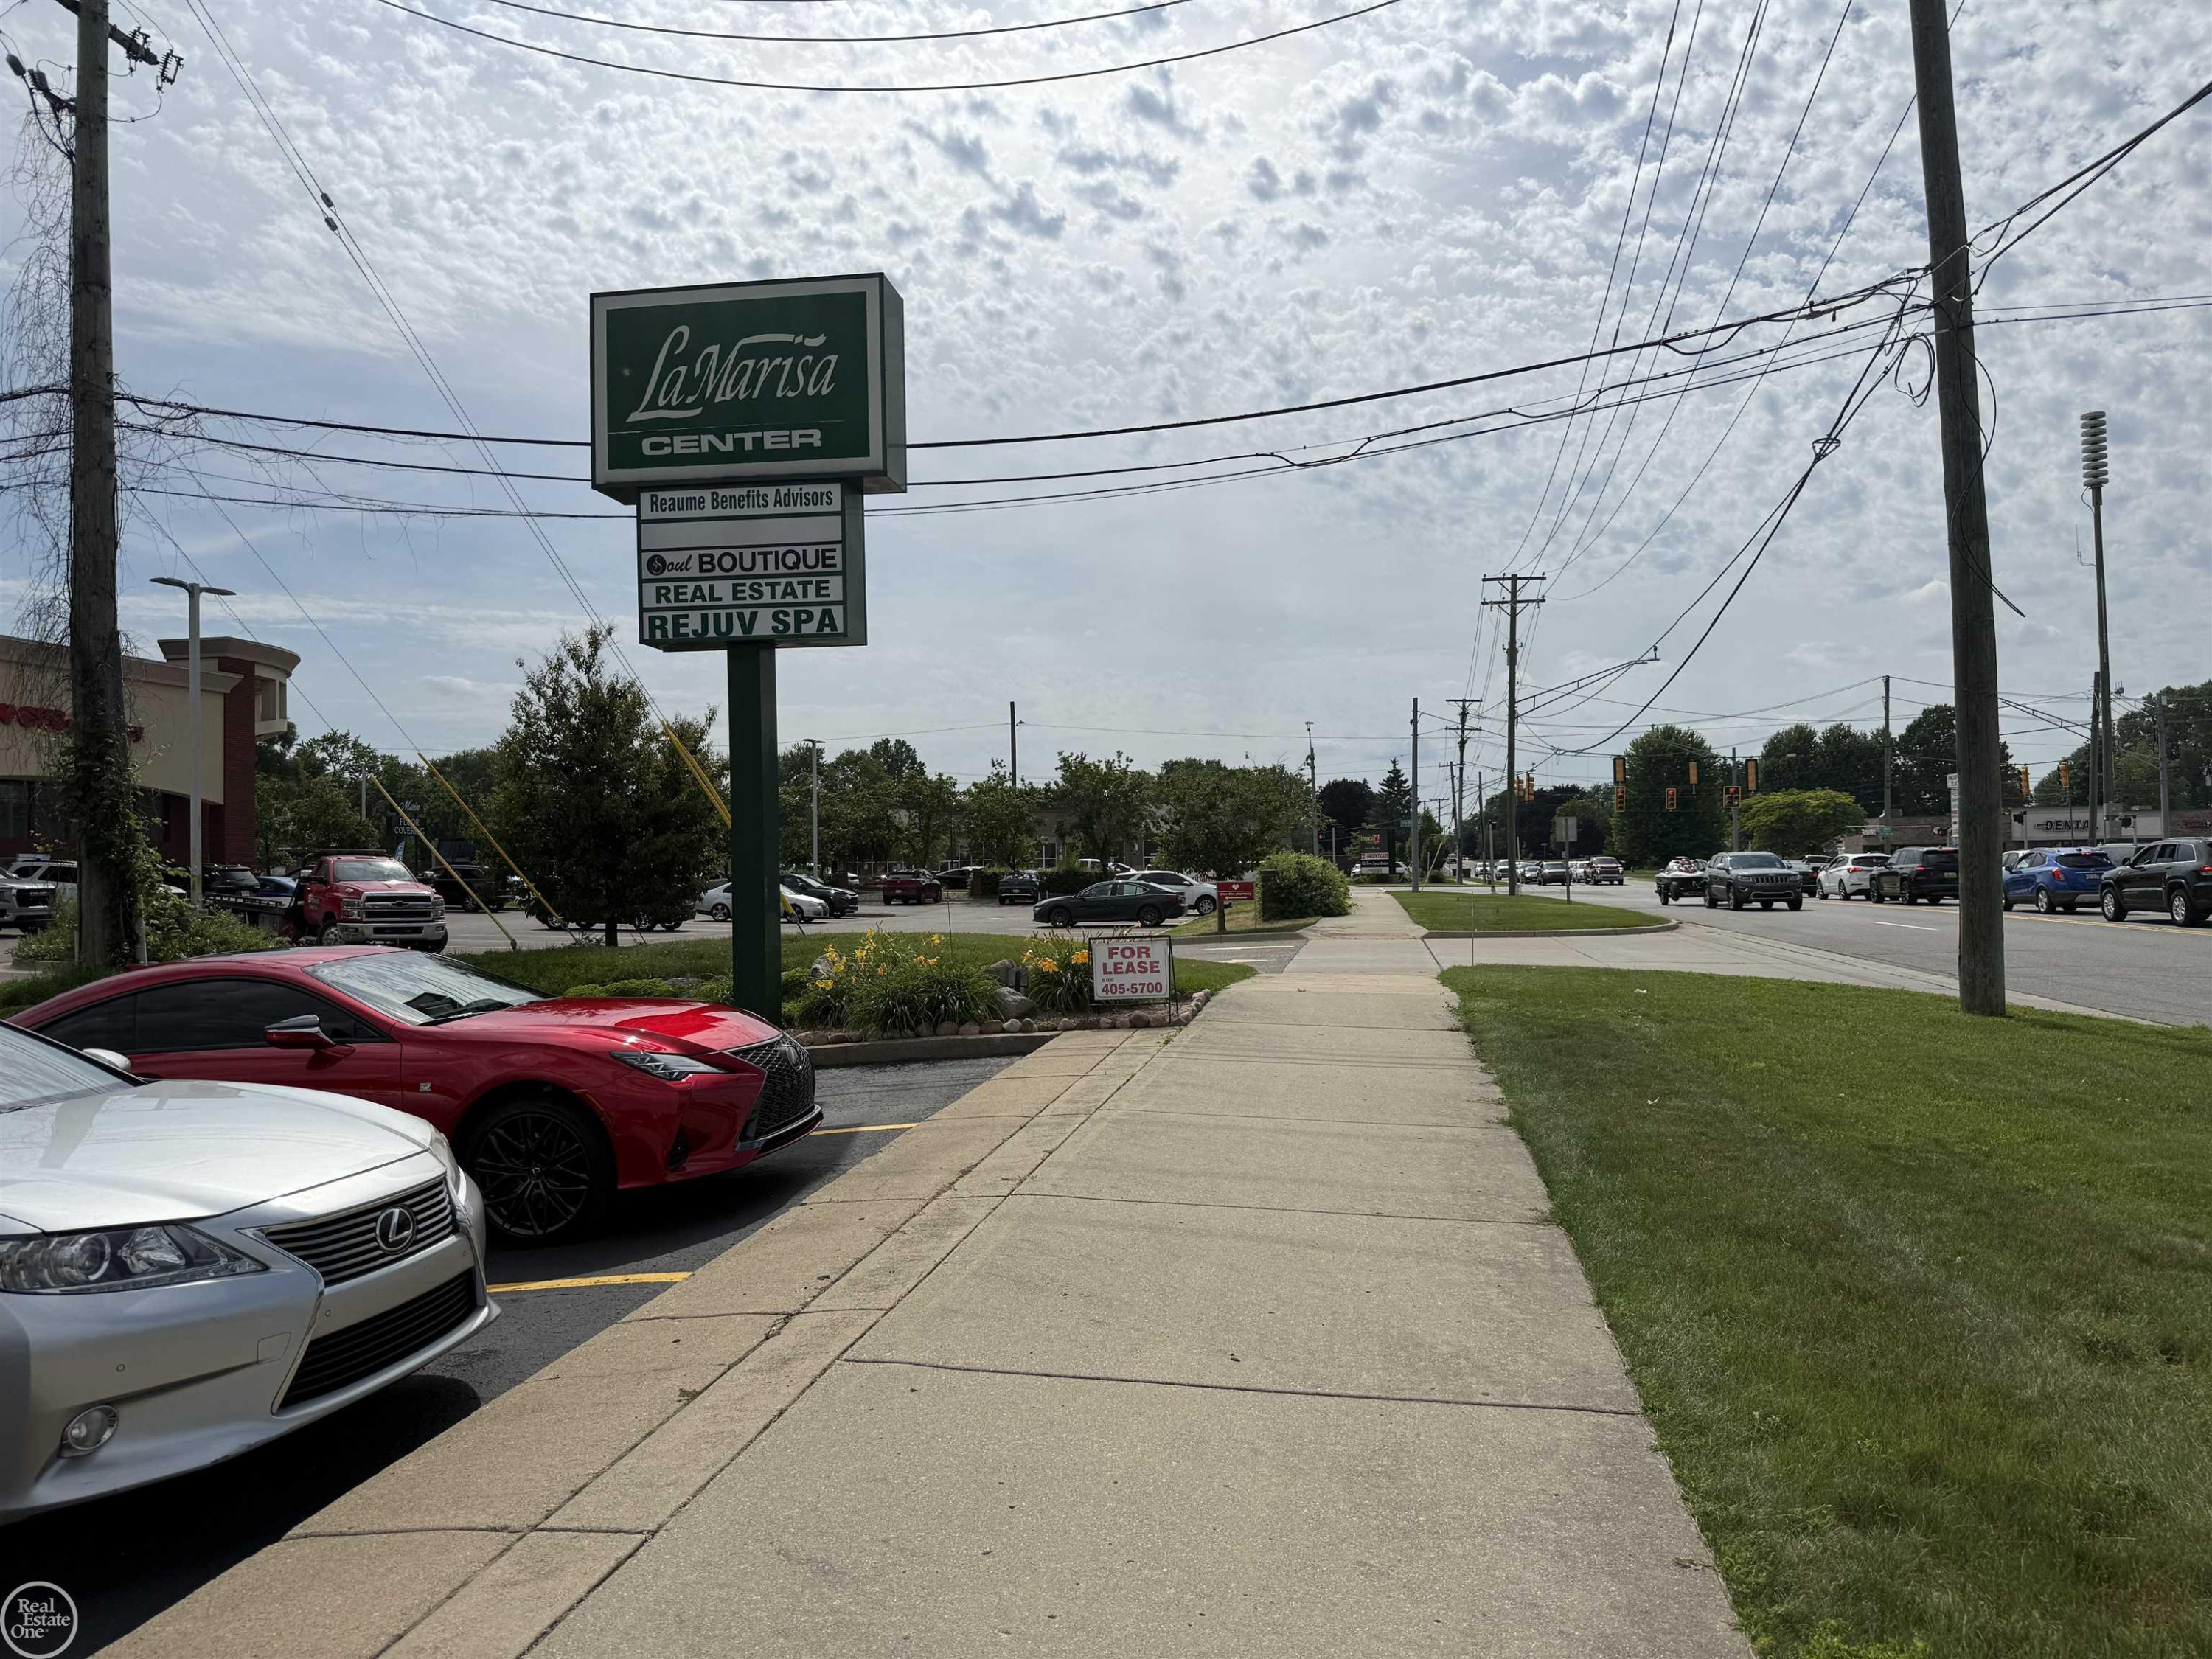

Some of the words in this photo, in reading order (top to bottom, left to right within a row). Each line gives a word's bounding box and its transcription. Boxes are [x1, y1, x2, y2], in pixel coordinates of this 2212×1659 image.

[641, 428, 822, 456] CENTER
[650, 493, 706, 513] Reaume
[710, 490, 769, 510] Benefits
[773, 487, 833, 508] Advisors
[646, 554, 692, 576] Soul
[698, 548, 838, 574] BOUTIQUE
[655, 584, 723, 605] REAL
[731, 580, 831, 602] ESTATE
[647, 611, 759, 639] REJUV
[771, 608, 839, 634] SPA
[2045, 820, 2098, 831] DENTA
[1108, 946, 1151, 959] FOR
[1102, 961, 1160, 975] LEASE
[1102, 982, 1163, 995] 405-5700
